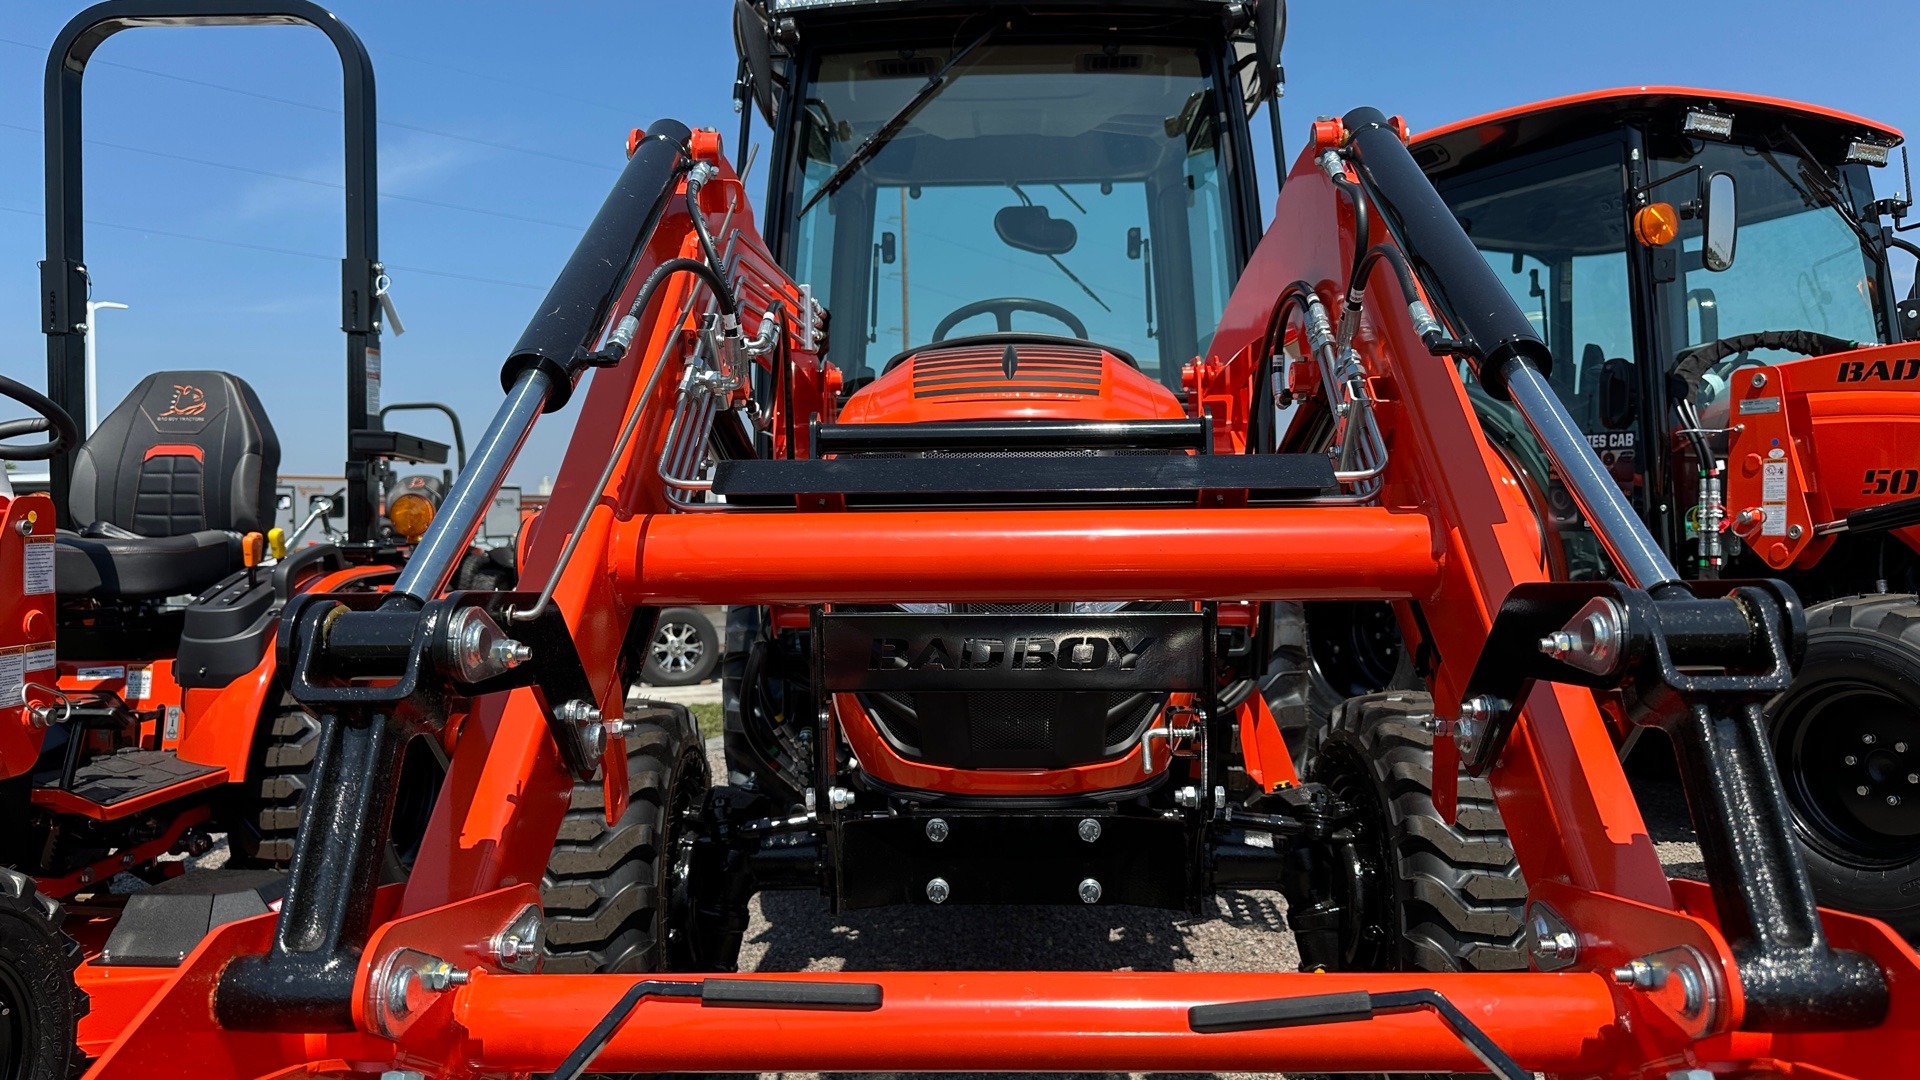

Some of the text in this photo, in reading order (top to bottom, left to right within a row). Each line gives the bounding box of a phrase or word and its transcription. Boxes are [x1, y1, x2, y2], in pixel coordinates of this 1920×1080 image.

[1837, 359, 1920, 382] BAD
[1609, 433, 1634, 447] CAB
[1862, 469, 1920, 494] 50
